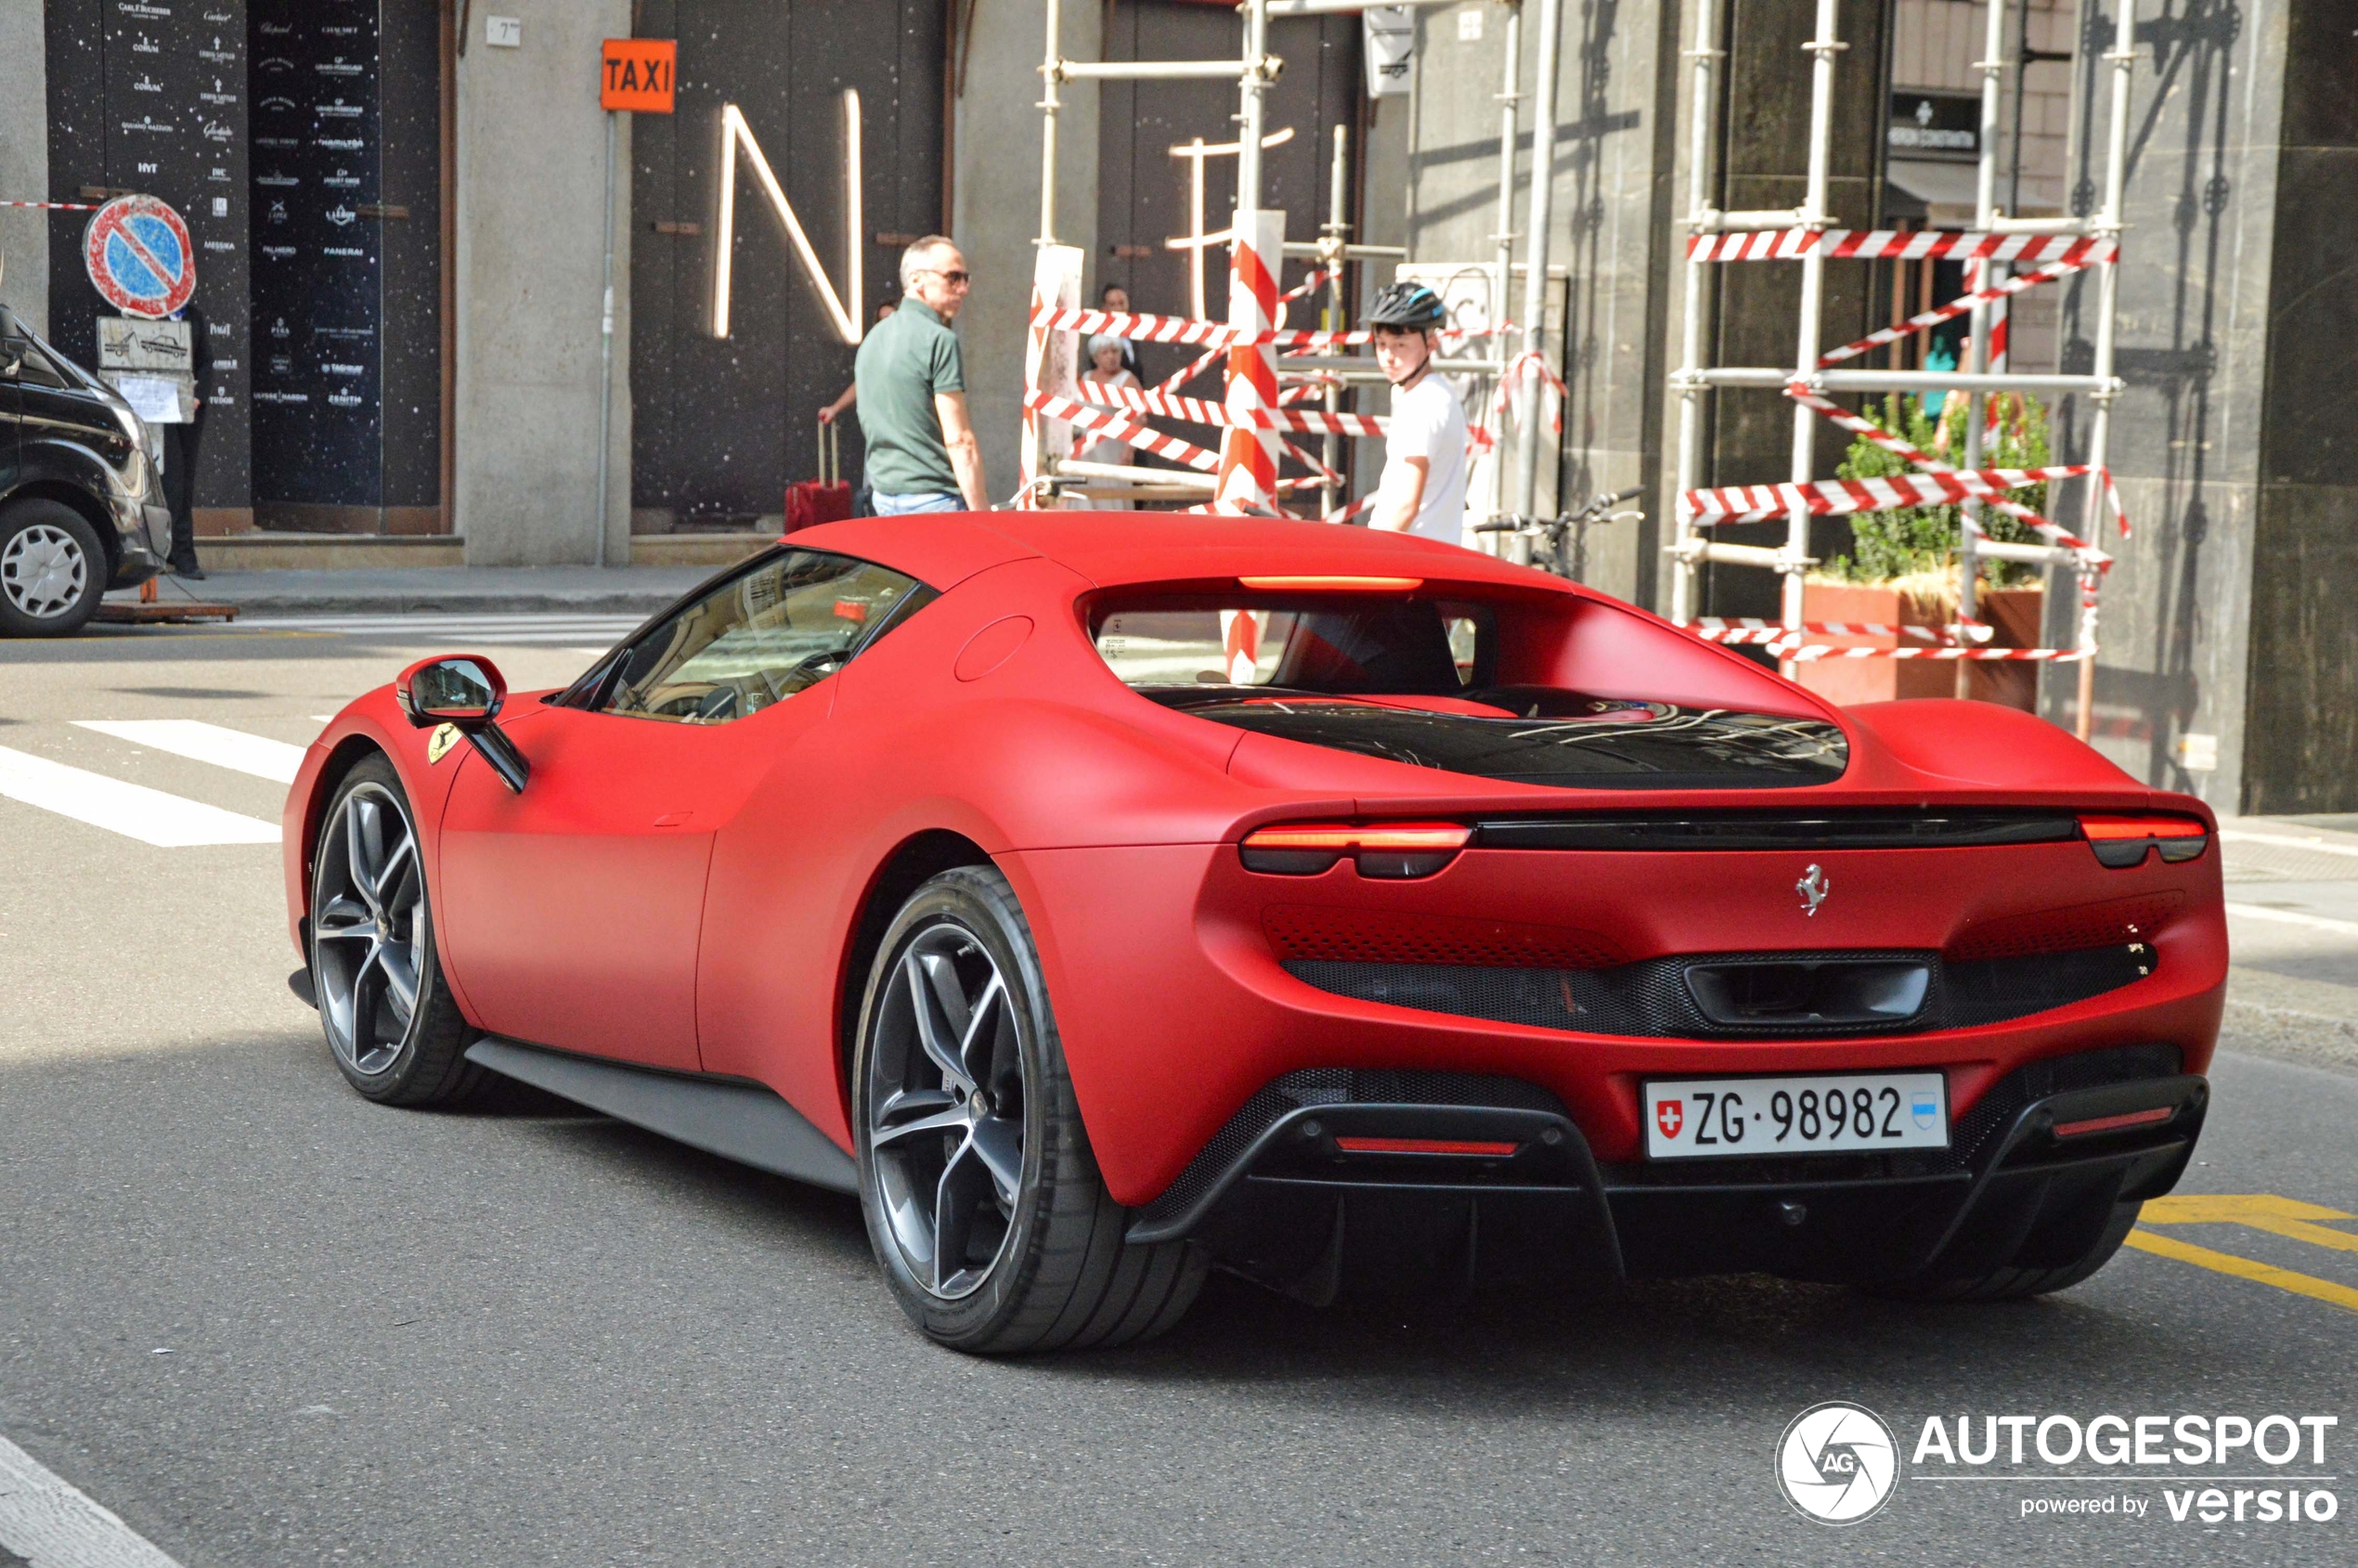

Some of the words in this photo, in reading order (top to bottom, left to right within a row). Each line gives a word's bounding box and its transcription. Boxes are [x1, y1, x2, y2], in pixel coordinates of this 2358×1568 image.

[133, 43, 159, 53] CORUM
[606, 58, 670, 92] TAXI
[137, 162, 158, 174] HYT
[713, 88, 862, 344] N
[203, 241, 235, 251] MESSIKA
[323, 247, 364, 256] PANERAI
[209, 395, 234, 405] TUDOR
[328, 395, 362, 405] ZENITH
